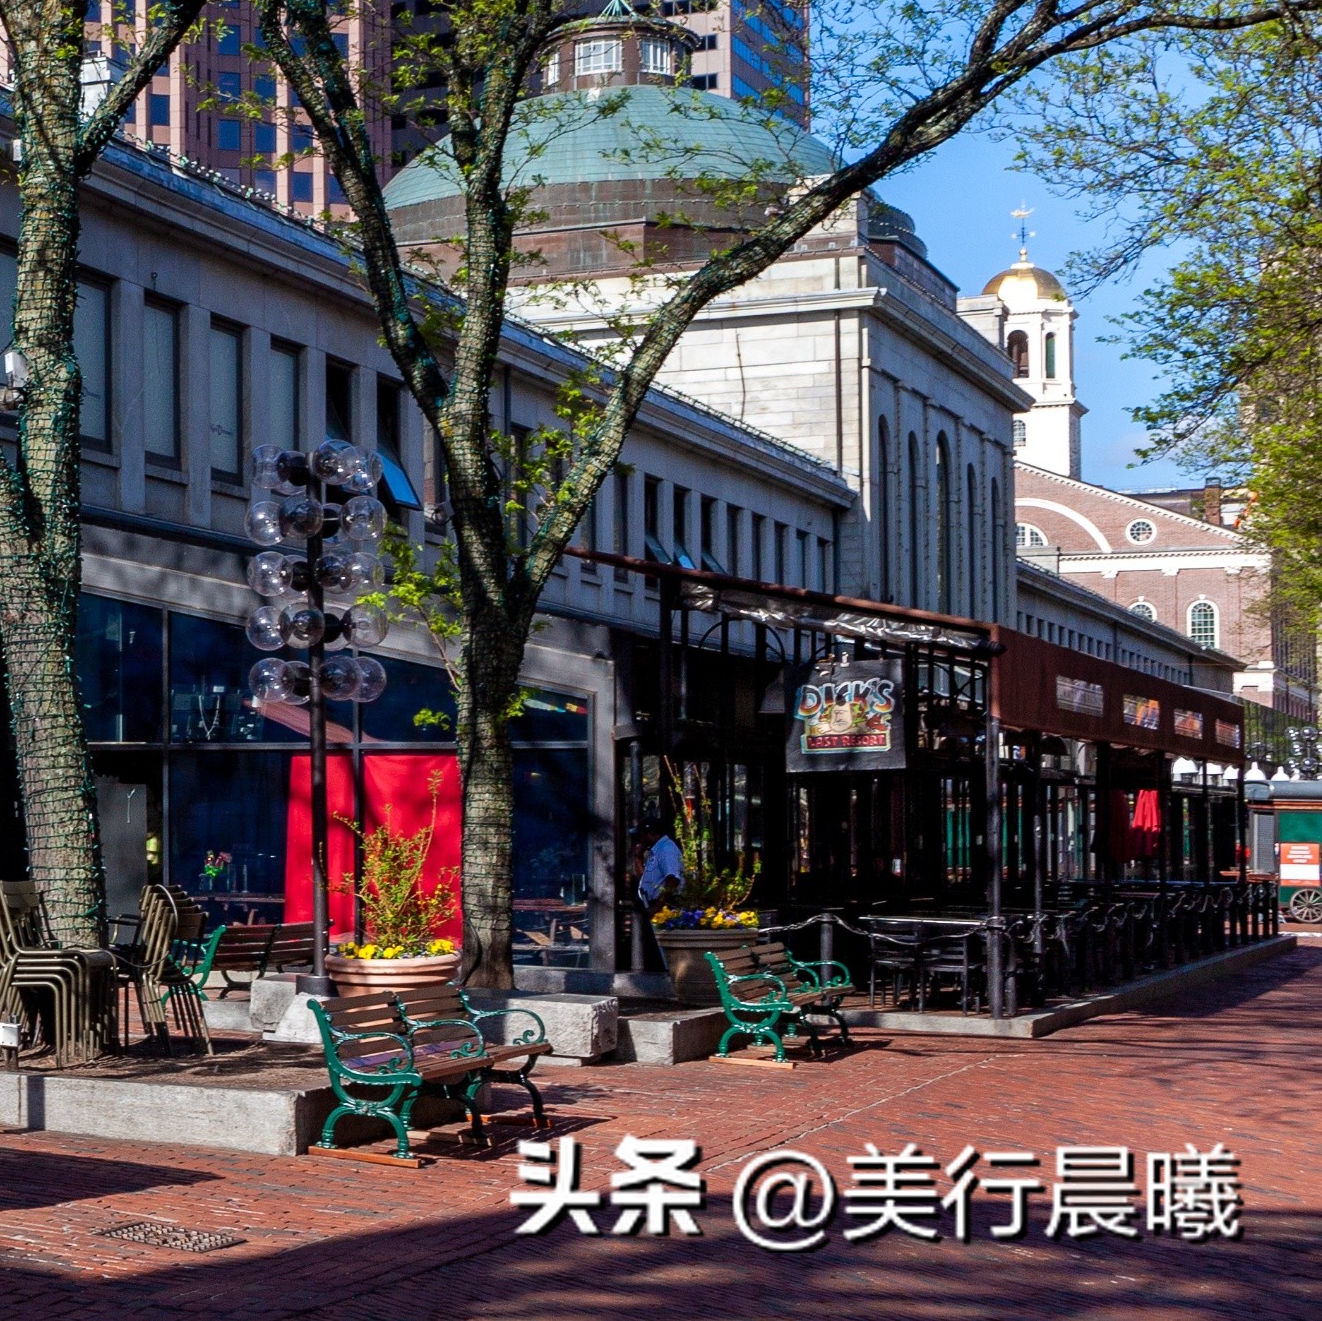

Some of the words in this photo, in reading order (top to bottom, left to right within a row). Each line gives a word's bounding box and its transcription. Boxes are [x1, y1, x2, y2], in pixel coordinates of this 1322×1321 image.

[796, 678, 895, 718] DICK'S
[808, 736, 838, 747] LAST
[841, 735, 886, 746] RESORT
